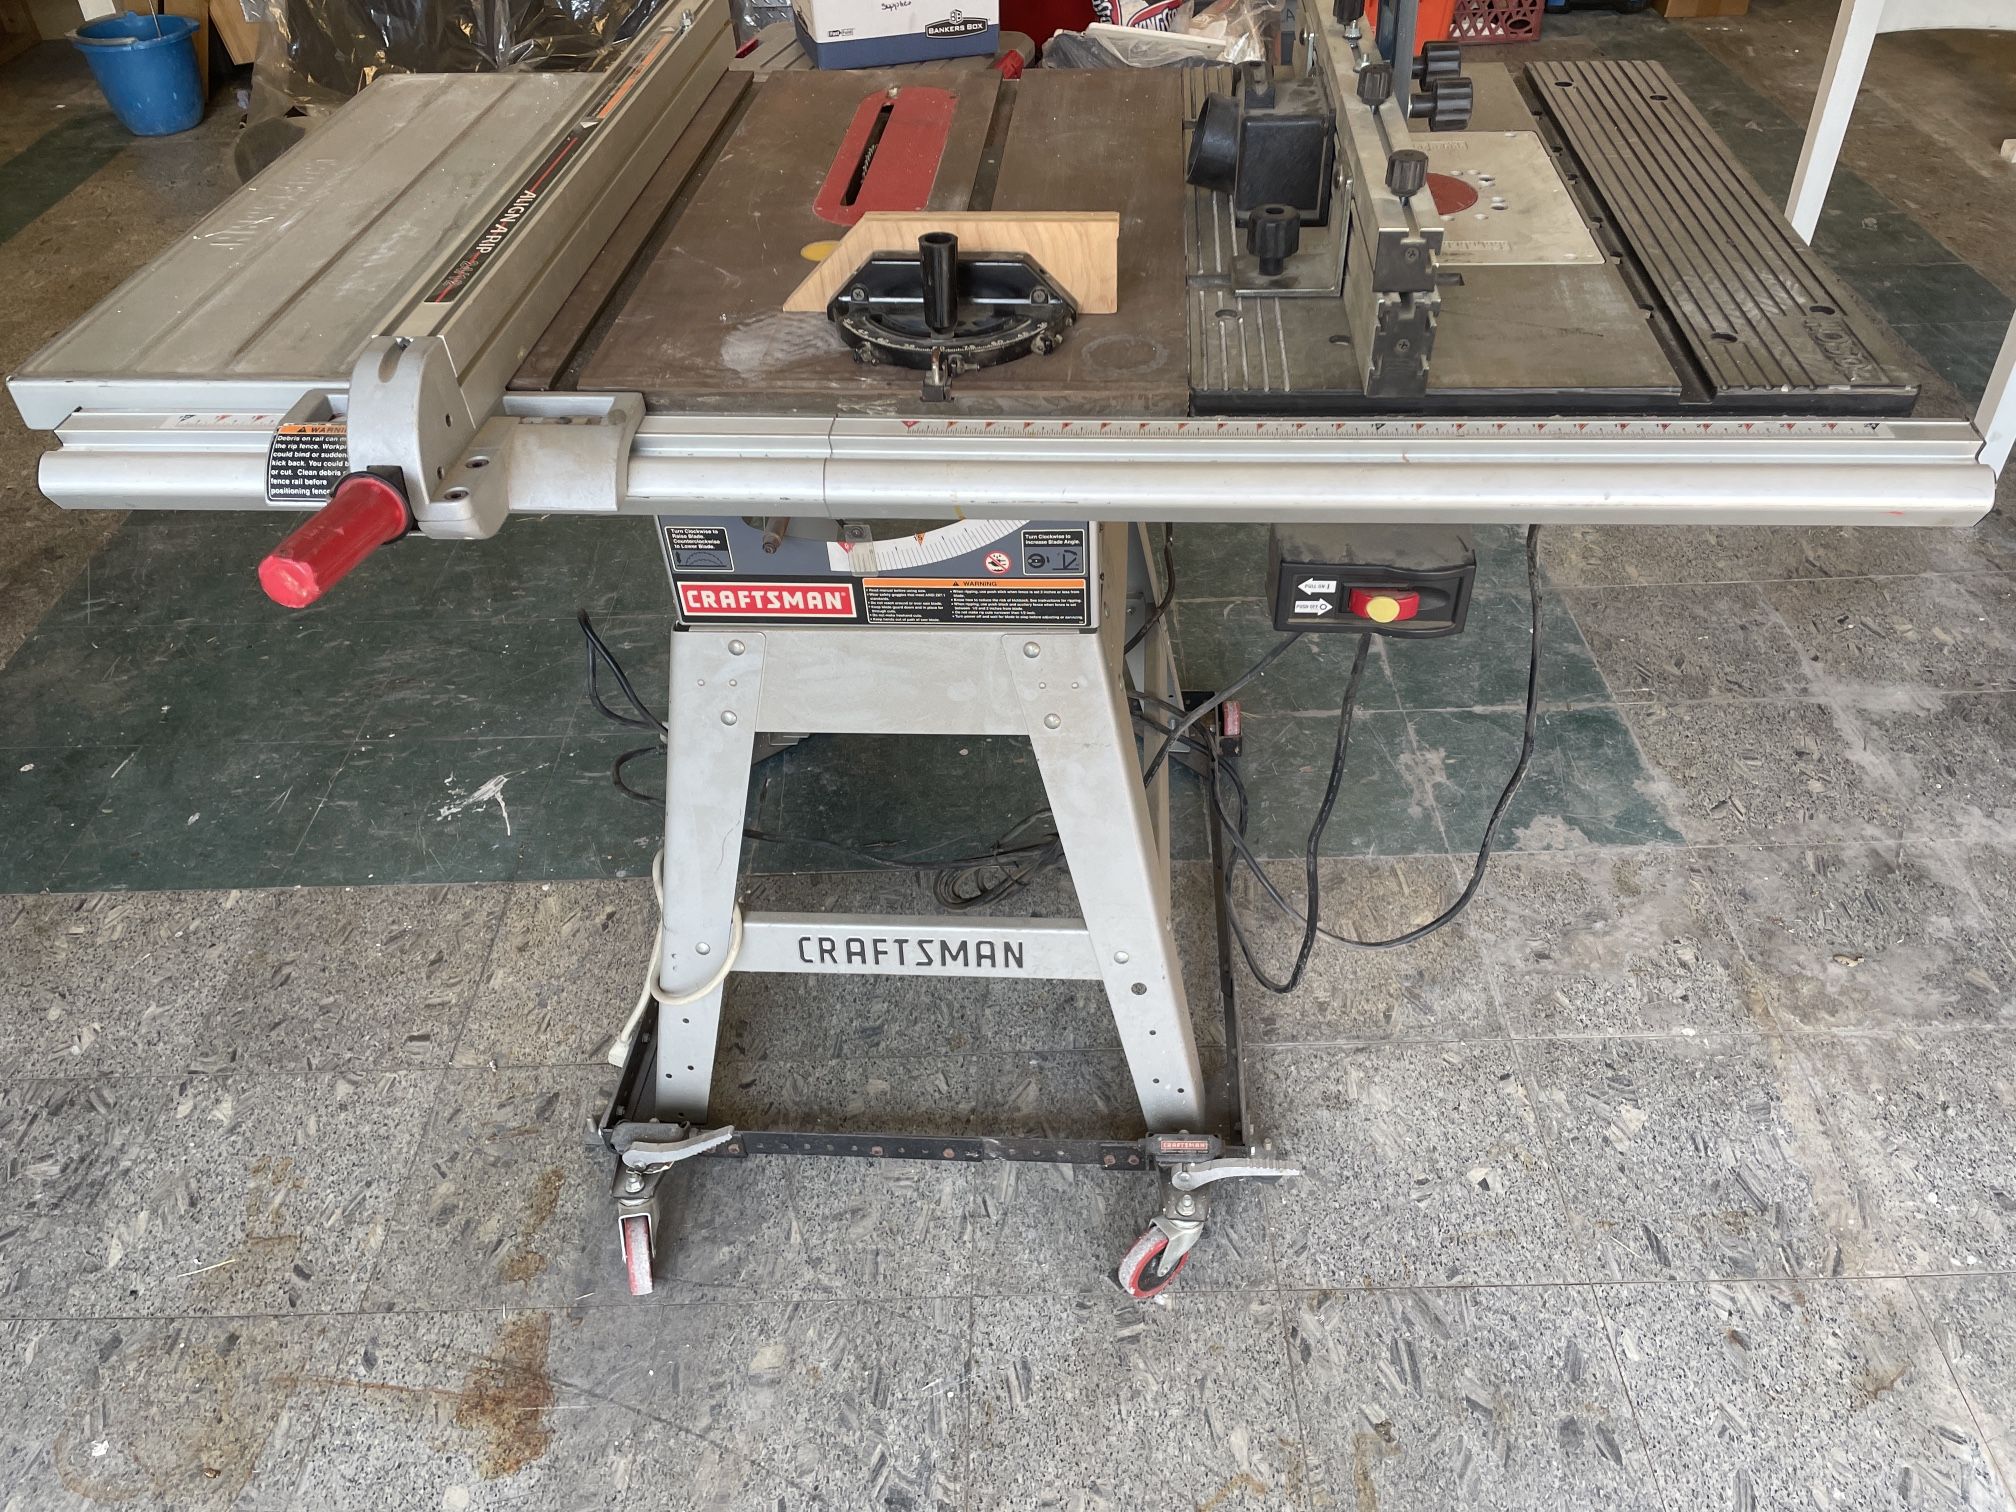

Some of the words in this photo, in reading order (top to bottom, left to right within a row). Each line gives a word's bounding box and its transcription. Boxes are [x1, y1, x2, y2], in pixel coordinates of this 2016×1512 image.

[928, 25, 965, 34] BANKERS
[500, 190, 537, 222] ALIGN
[476, 235, 502, 254] RIP
[271, 488, 310, 496] positioning
[686, 590, 843, 610] CRAFTSMAN
[798, 936, 1023, 968] CRAFTSMAN
